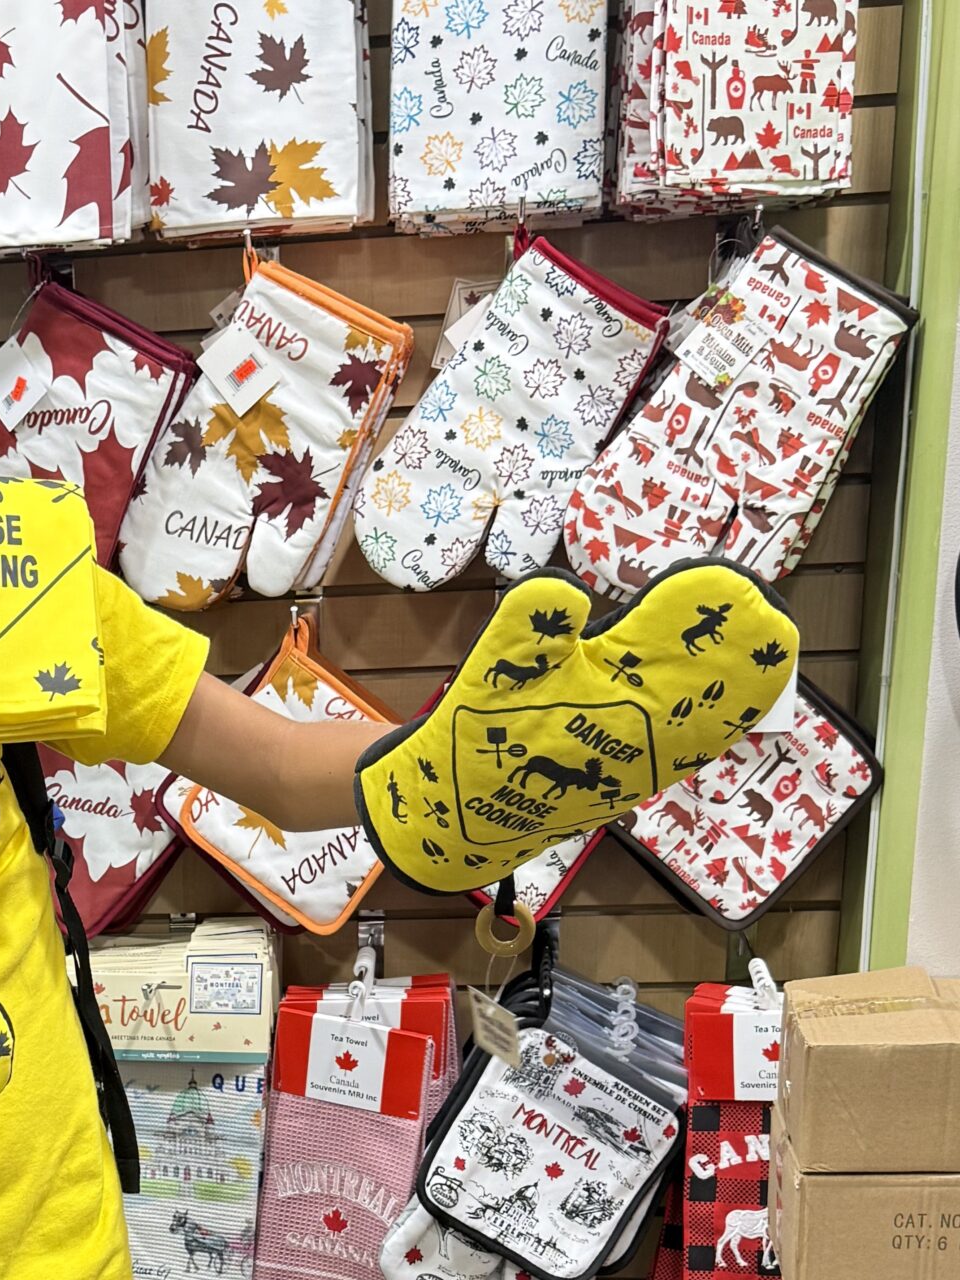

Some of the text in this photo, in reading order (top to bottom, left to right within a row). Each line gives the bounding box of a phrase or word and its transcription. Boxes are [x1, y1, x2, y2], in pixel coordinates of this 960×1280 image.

[545, 35, 600, 72] Canada
[691, 30, 732, 47] Canada
[186, 2, 239, 134] CANADA
[425, 57, 454, 119] Canada
[792, 126, 833, 141] Canada
[510, 147, 567, 191] Canada
[747, 276, 792, 307] Canada
[485, 310, 529, 357] Canada
[434, 447, 481, 491] Canada
[541, 464, 589, 489] anada
[667, 460, 709, 487] Canada
[564, 713, 644, 765] DANGER
[464, 796, 545, 833] COOKING
[490, 785, 559, 819] MOOSE
[280, 826, 371, 896] ANADA
[667, 857, 702, 891] Canada
[113, 995, 188, 1031] towel
[754, 1024, 769, 1034] Tea
[331, 1033, 369, 1048] Tea Towel
[310, 1082, 347, 1096] Souvenirs
[329, 1074, 360, 1089] Canada
[571, 1067, 663, 1126] ENSEMBLE DE CUISINE
[650, 1105, 669, 1118] SET
[512, 1102, 602, 1171] MONTRÉAL
[272, 1160, 401, 1228] MONTREAL
[893, 1212, 932, 1229] CAT.
[286, 1231, 375, 1269] CANADA
[891, 1234, 948, 1251] QTY: 6
